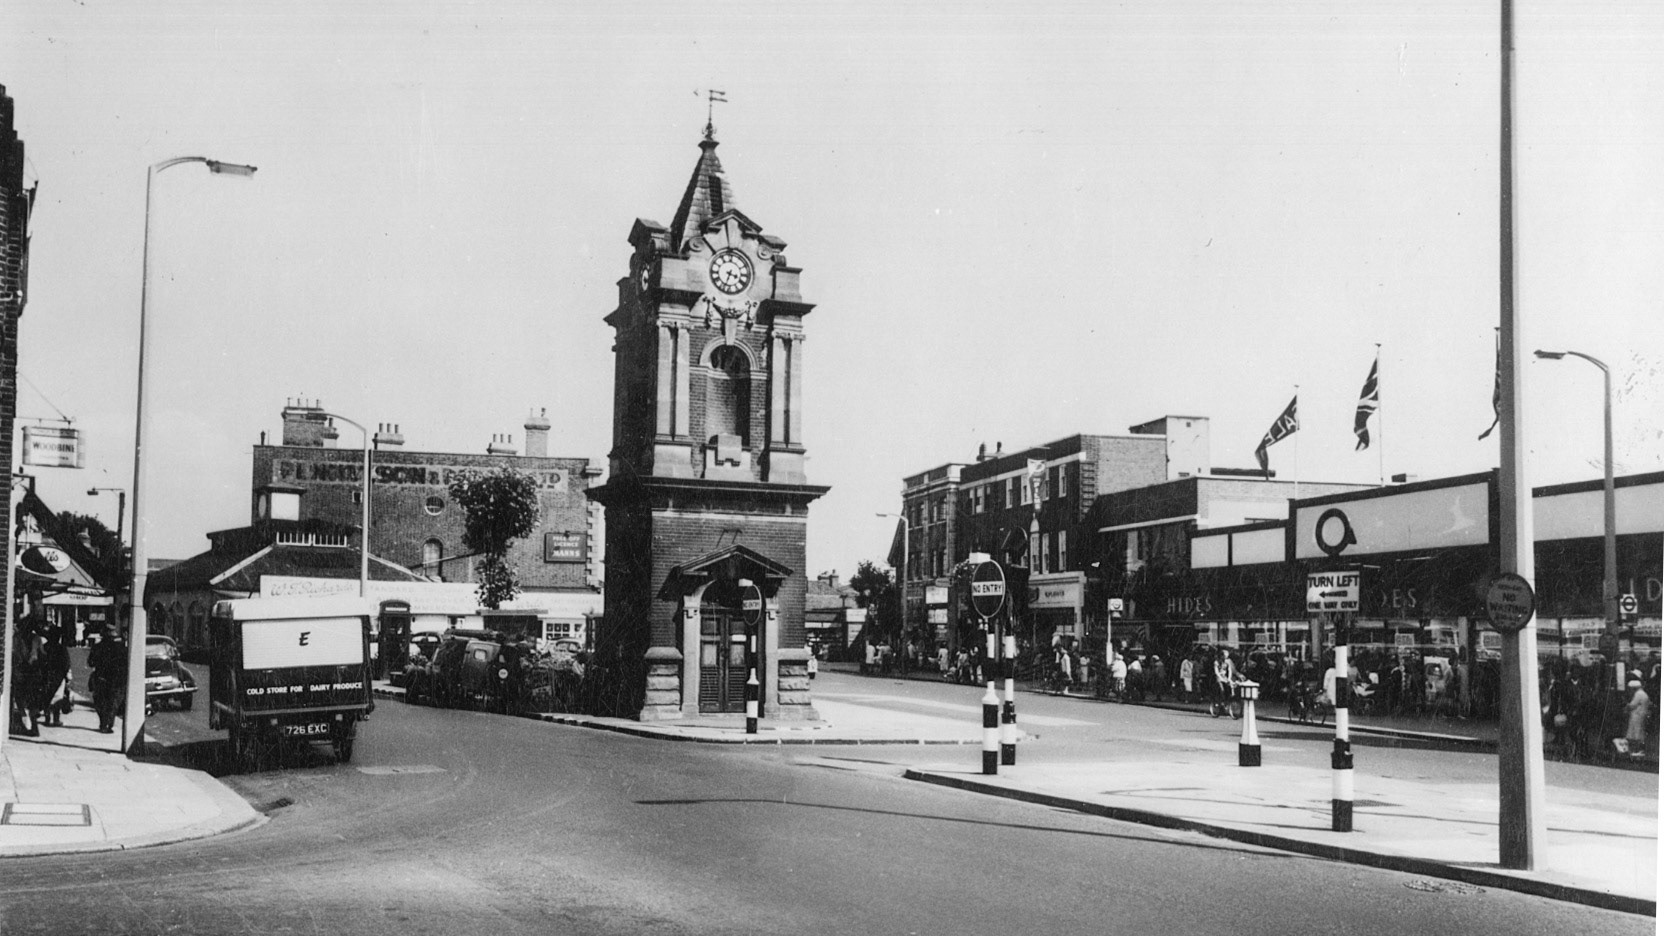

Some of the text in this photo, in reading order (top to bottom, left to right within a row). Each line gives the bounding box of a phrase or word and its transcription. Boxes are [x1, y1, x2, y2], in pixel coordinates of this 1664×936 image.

[1308, 575, 1359, 588] TURN LEFT
[972, 584, 1002, 593] NO ENTRY
[1167, 597, 1212, 613] HIDES
[1308, 601, 1358, 610] ONE WAY ONLY
[299, 631, 311, 646] E
[246, 682, 363, 696] COLD STORE FOR DAIRY PRODUCE
[286, 723, 328, 735] 726 EXC
